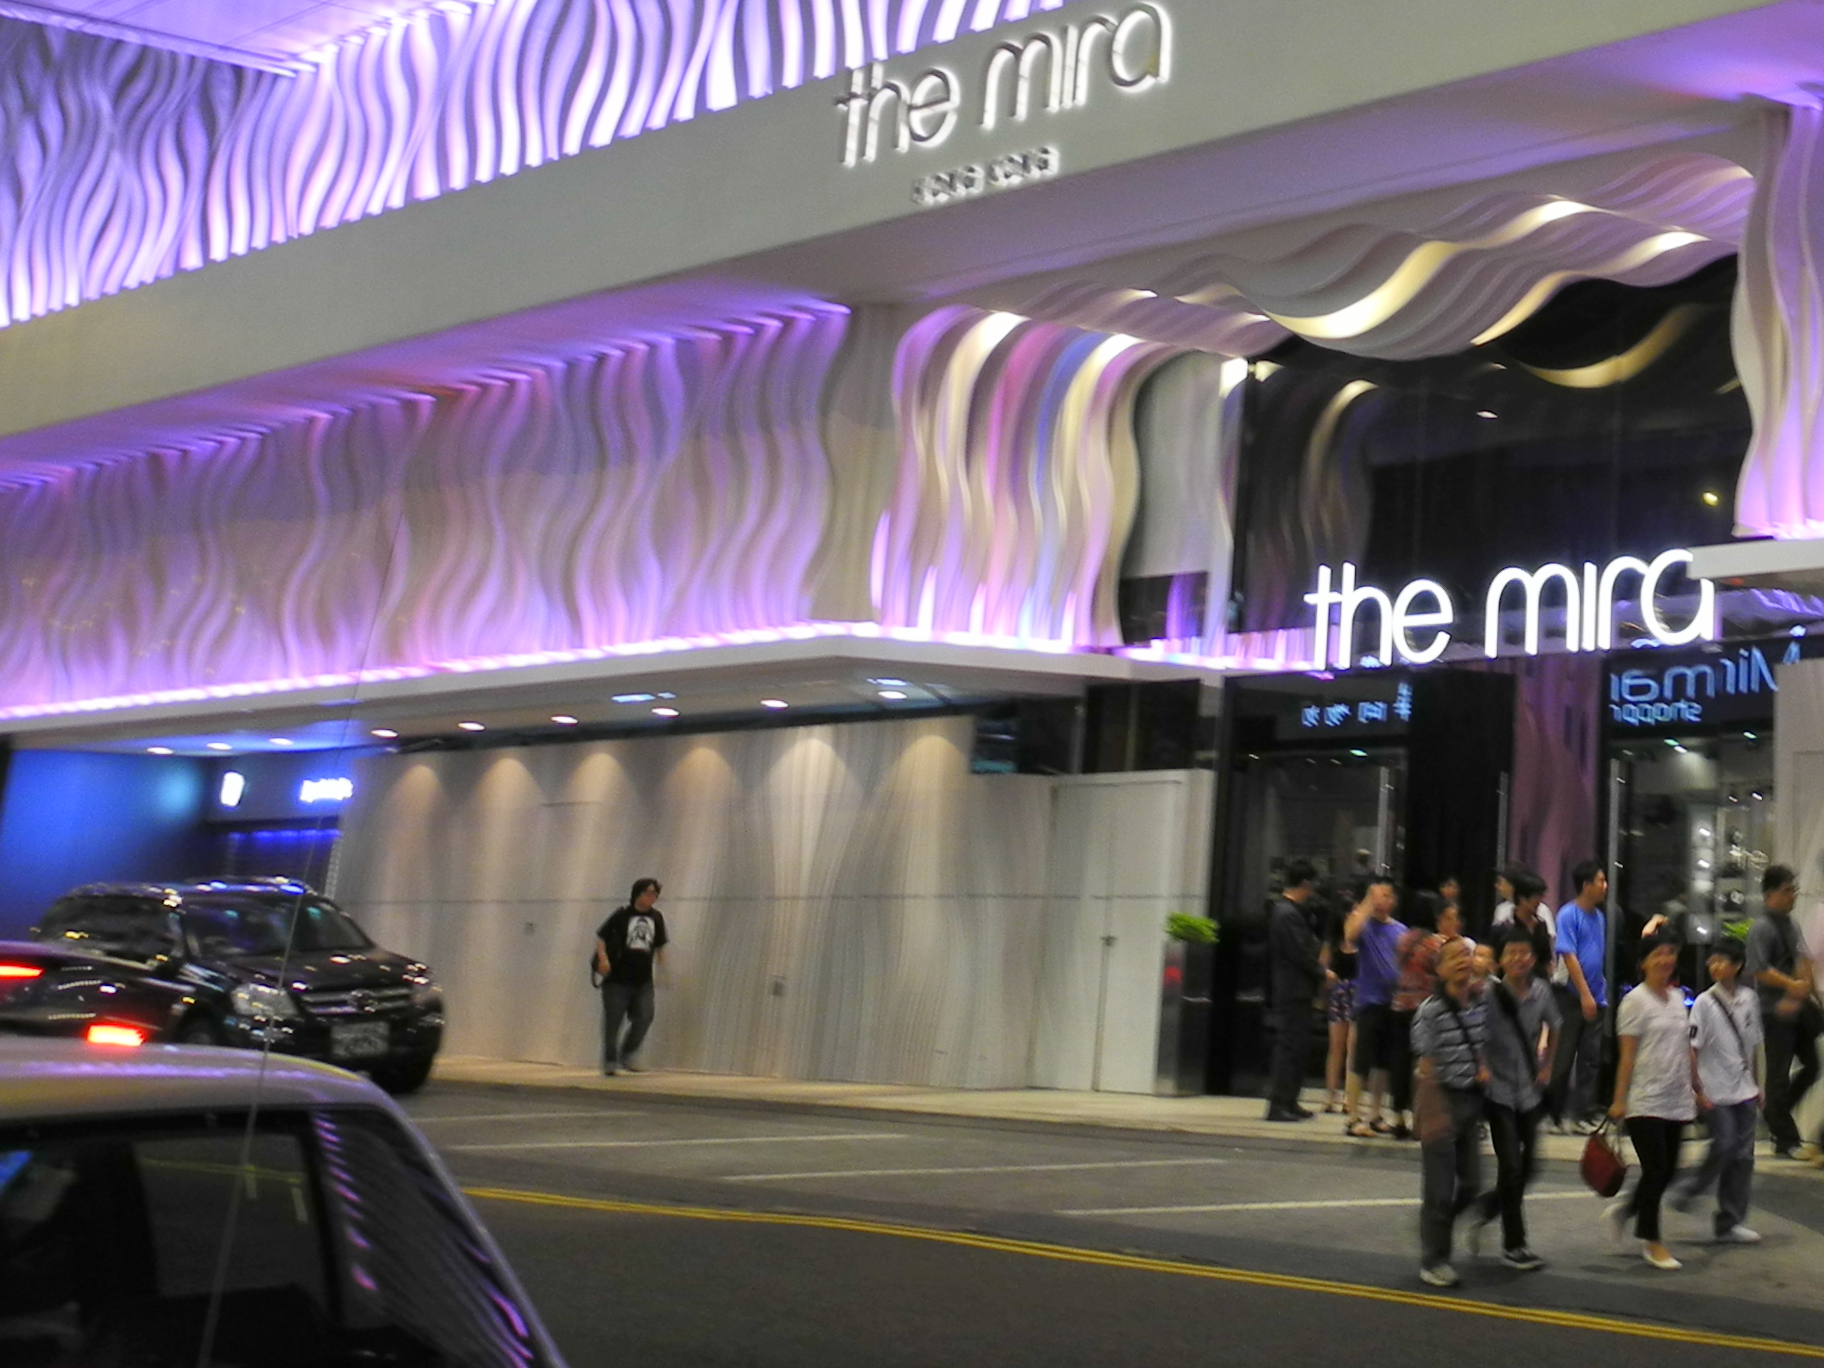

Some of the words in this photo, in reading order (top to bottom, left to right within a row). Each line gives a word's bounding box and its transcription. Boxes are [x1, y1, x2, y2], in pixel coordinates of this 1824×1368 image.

[833, 62, 961, 169] the
[980, 2, 1172, 131] mira
[1304, 561, 1454, 670] the
[1485, 548, 1715, 659] mira
